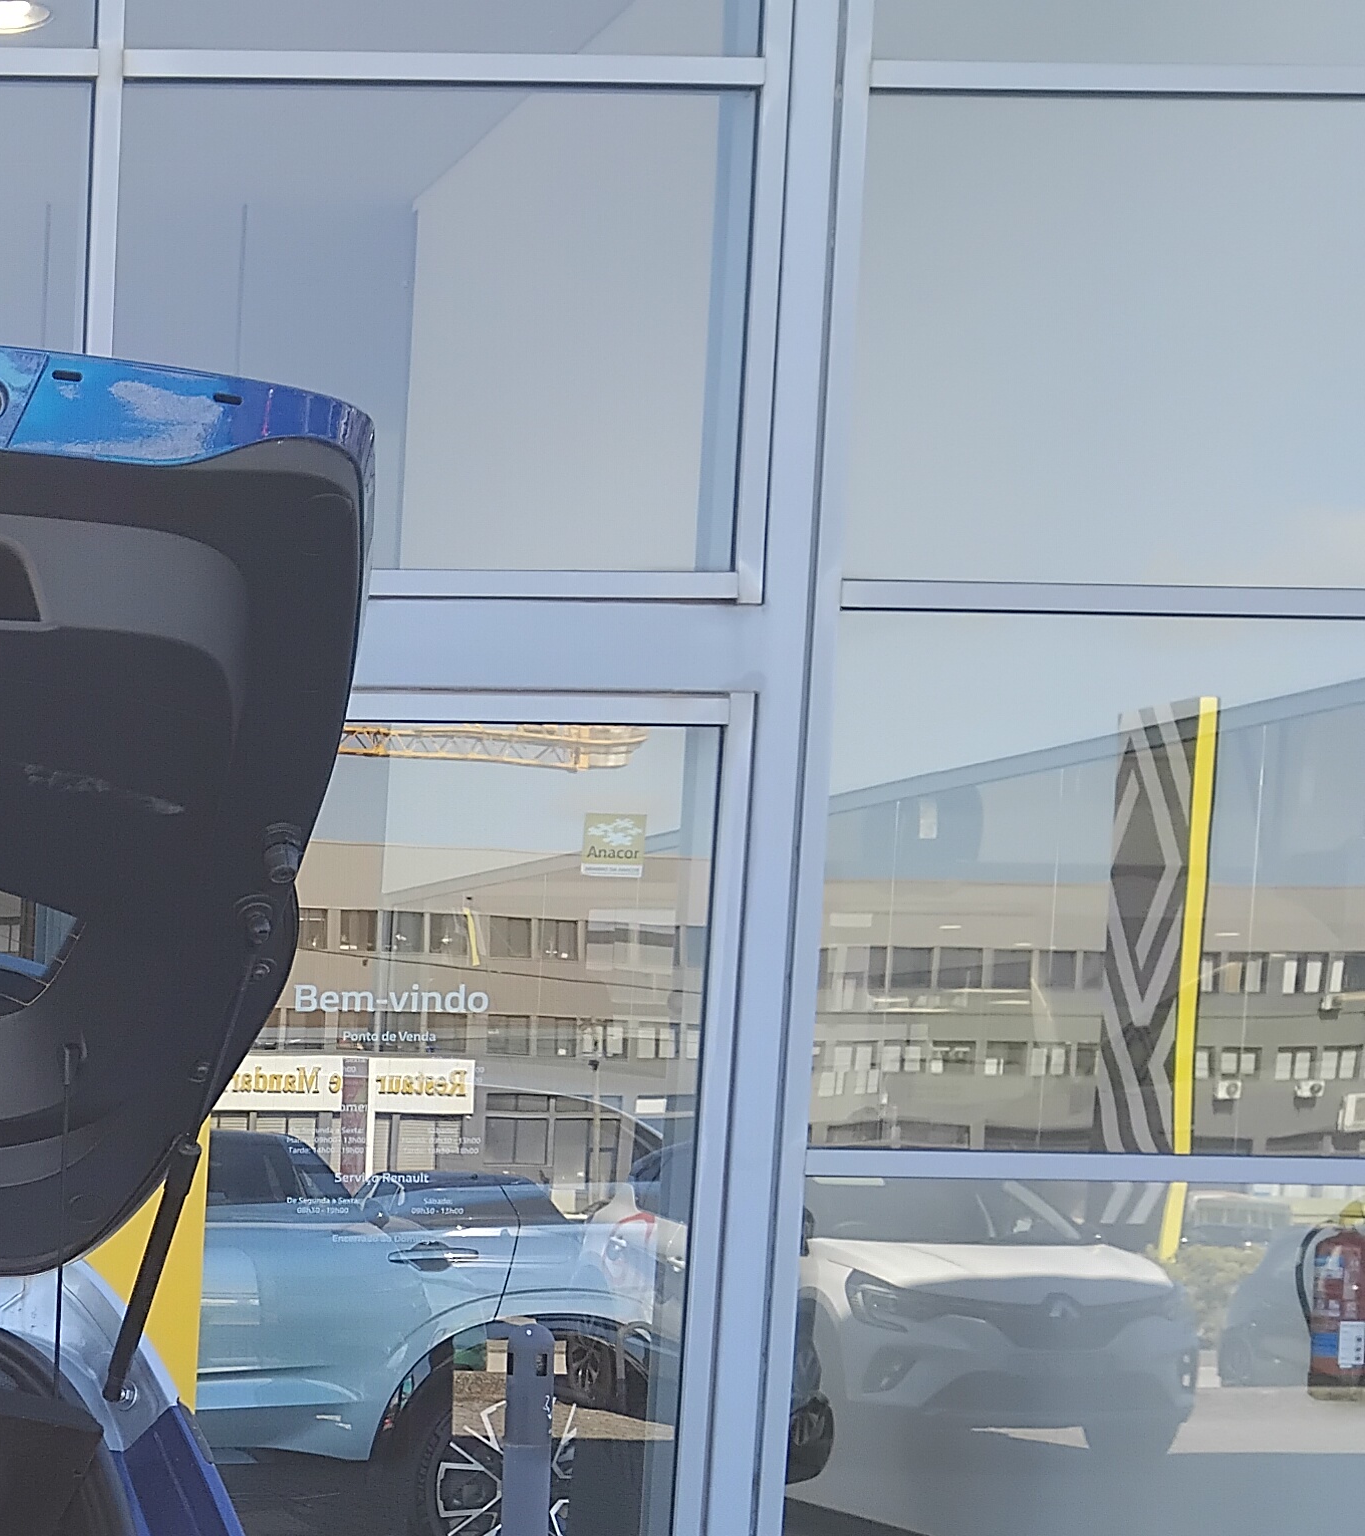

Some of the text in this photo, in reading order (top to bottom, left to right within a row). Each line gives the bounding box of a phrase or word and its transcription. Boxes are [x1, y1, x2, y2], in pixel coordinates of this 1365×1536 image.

[587, 845, 639, 859] Anacor
[294, 983, 489, 1013] Bem-vindo
[343, 1031, 437, 1042] Ponto de Venda
[335, 1172, 429, 1185] Serviço Renault
